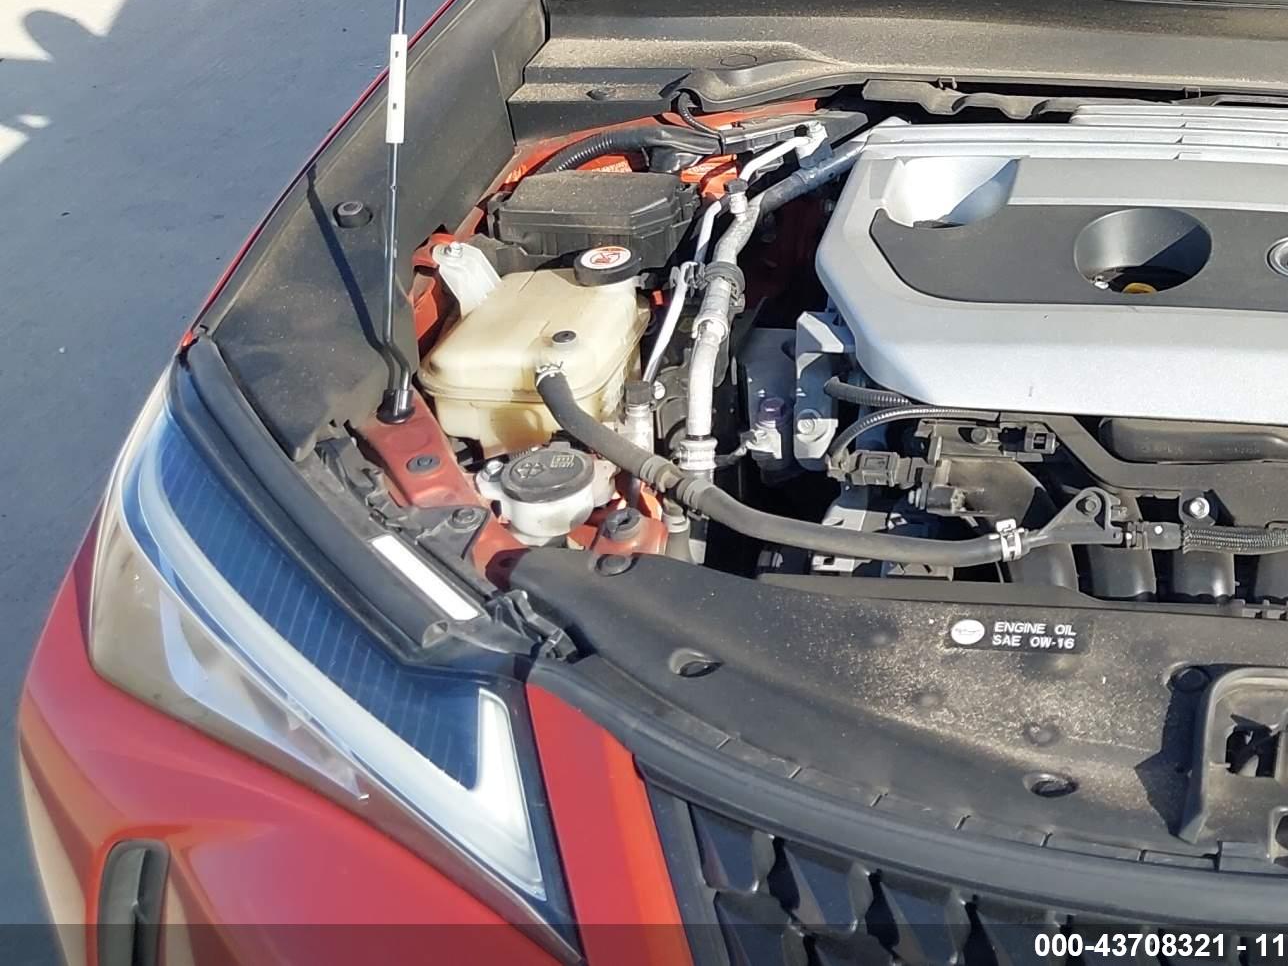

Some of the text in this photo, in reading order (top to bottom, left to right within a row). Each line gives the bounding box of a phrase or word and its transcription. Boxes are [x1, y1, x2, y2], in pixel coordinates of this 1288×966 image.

[994, 621, 1077, 636] ENGINE OIL
[992, 635, 1022, 646] SAE
